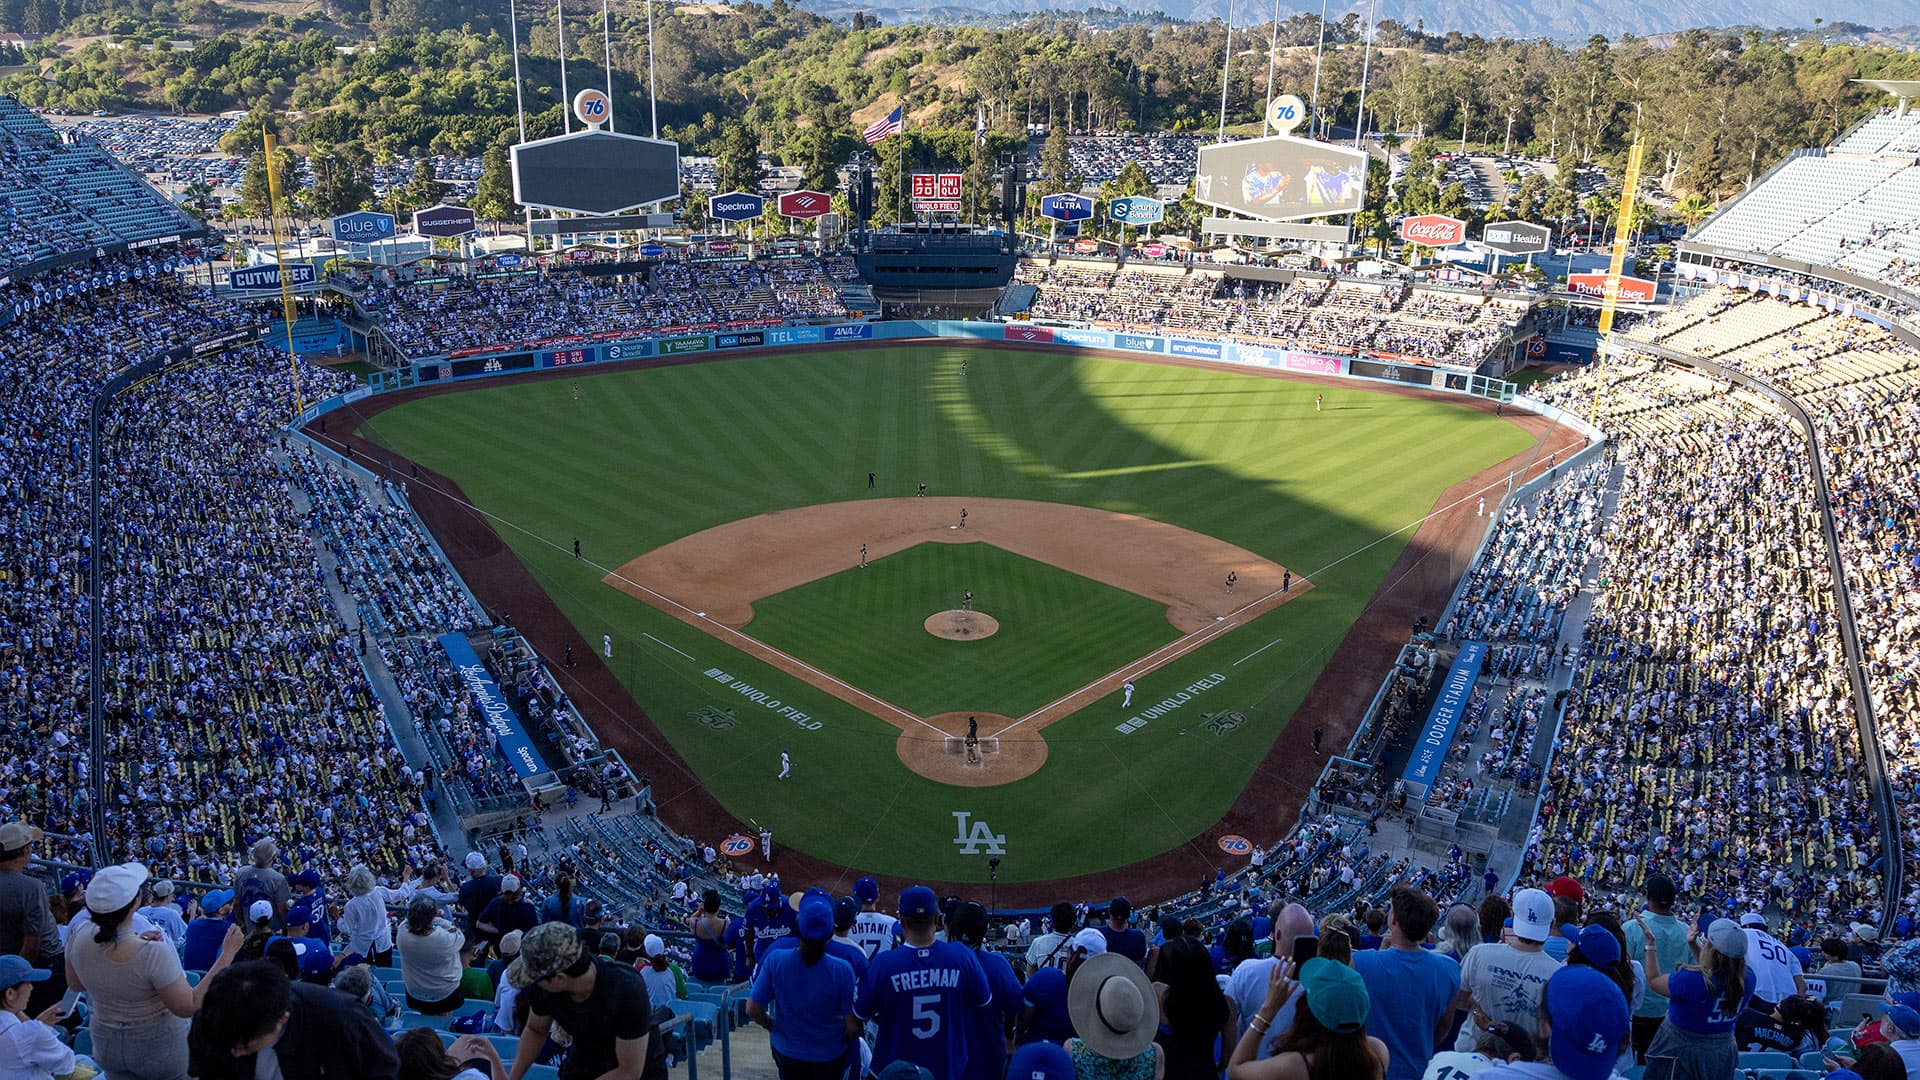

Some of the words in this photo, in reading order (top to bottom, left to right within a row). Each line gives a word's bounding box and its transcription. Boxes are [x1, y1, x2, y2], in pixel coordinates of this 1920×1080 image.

[584, 98, 605, 117] 76
[1276, 105, 1296, 120] 76
[942, 178, 958, 187] UNI
[941, 187, 959, 196] QLO
[716, 202, 755, 213] Spectrum
[1052, 201, 1082, 210] ULTRA
[1129, 203, 1159, 213] Security
[1129, 211, 1155, 219] Benefit
[339, 217, 374, 233] blue
[421, 217, 472, 227] GUGGENHEIM
[1407, 221, 1456, 242] Coca-Cola
[1512, 233, 1542, 245] Health
[1575, 282, 1646, 299] Budiser
[770, 331, 794, 343] TEL
[834, 327, 853, 336] ANA
[1062, 331, 1105, 344] Spectrum
[739, 335, 761, 344] Health
[1125, 336, 1146, 347] blue
[1172, 343, 1220, 356] smartwater
[1291, 355, 1324, 366] DAISO
[1141, 691, 1192, 720] UNIQLO
[1186, 672, 1227, 696] FIELD
[729, 681, 782, 709] UNIQLO
[777, 705, 824, 731] FIELD
[1425, 707, 1455, 747] DODGER
[1444, 668, 1472, 706] STADIUM
[951, 811, 1007, 855] LA
[725, 838, 751, 853] 76
[1223, 838, 1249, 852] 76
[851, 921, 888, 936] OHTANI
[1758, 939, 1788, 966] 50
[889, 968, 961, 993] FREEMAN
[911, 994, 942, 1040] 5
